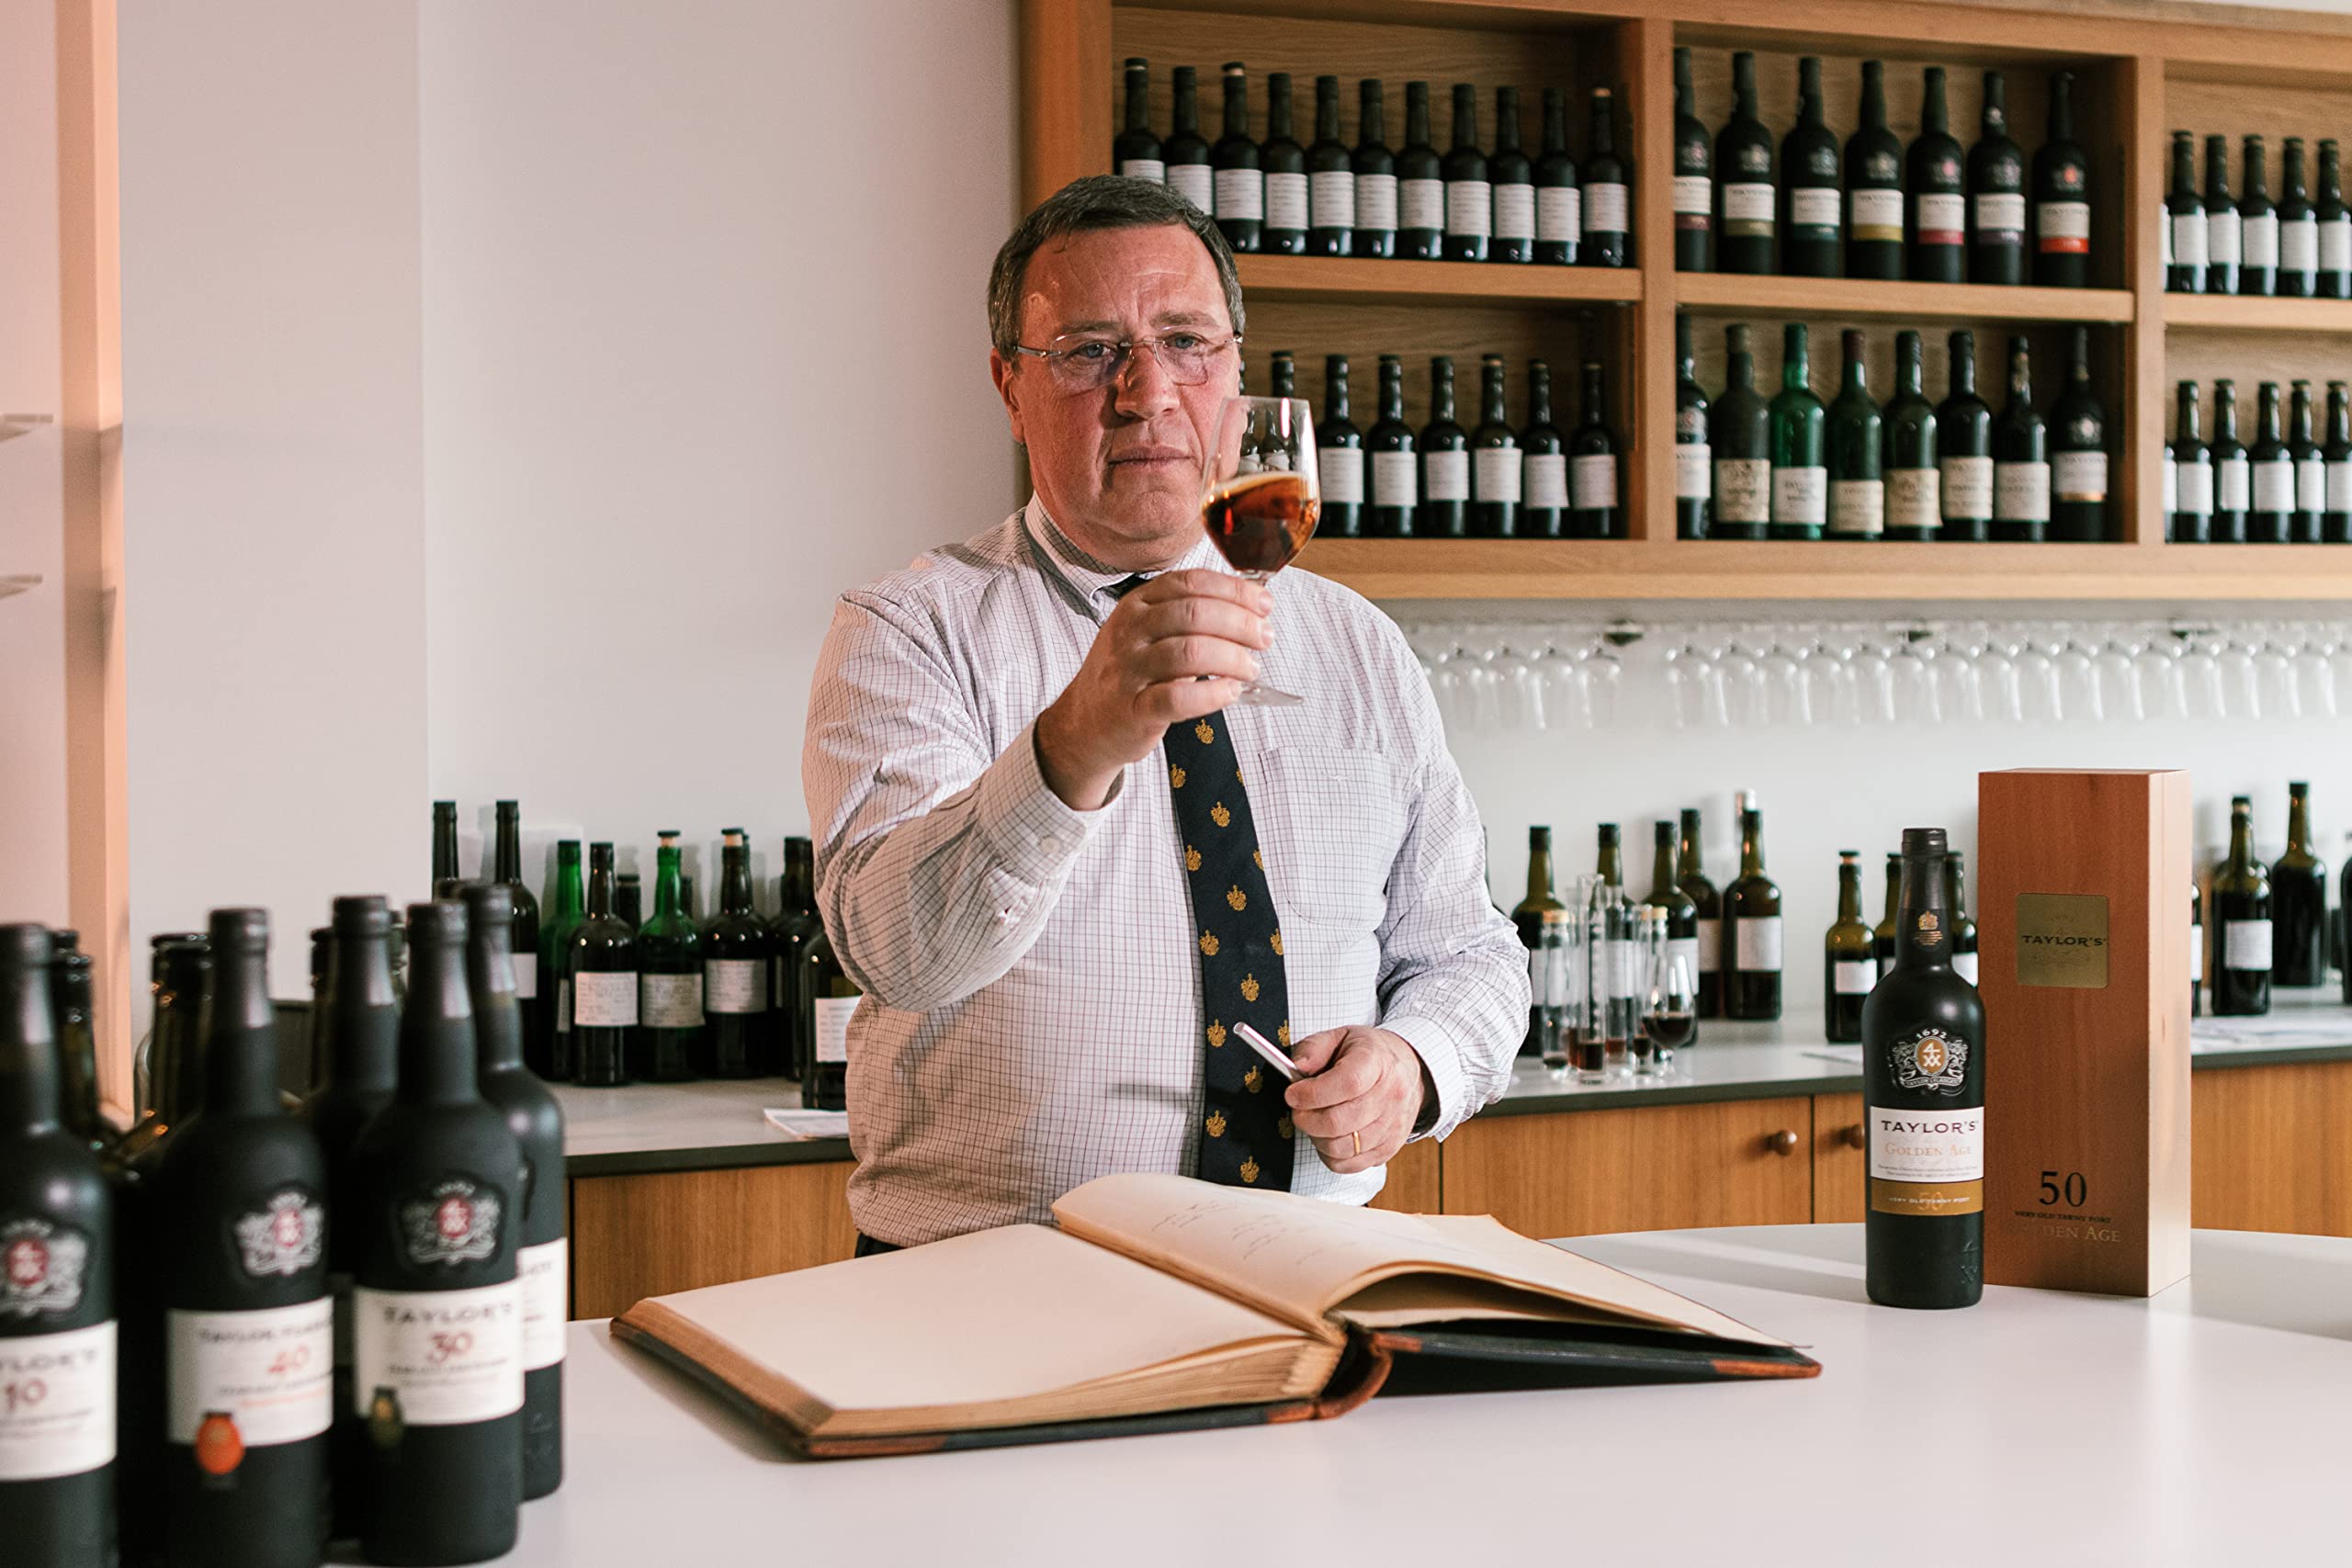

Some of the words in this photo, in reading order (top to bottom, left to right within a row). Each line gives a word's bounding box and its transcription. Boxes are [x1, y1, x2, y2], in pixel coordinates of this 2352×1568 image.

[2021, 935, 2103, 948] TAYLOR'S
[1917, 1028, 1947, 1039] 1692
[1881, 1120, 1976, 1134] TAYLOR'S
[2039, 1170, 2087, 1207] 50
[2085, 1225, 2121, 1242] AGE
[267, 1344, 311, 1375] 40
[426, 1331, 473, 1364] 30
[4, 1377, 48, 1413] 10
